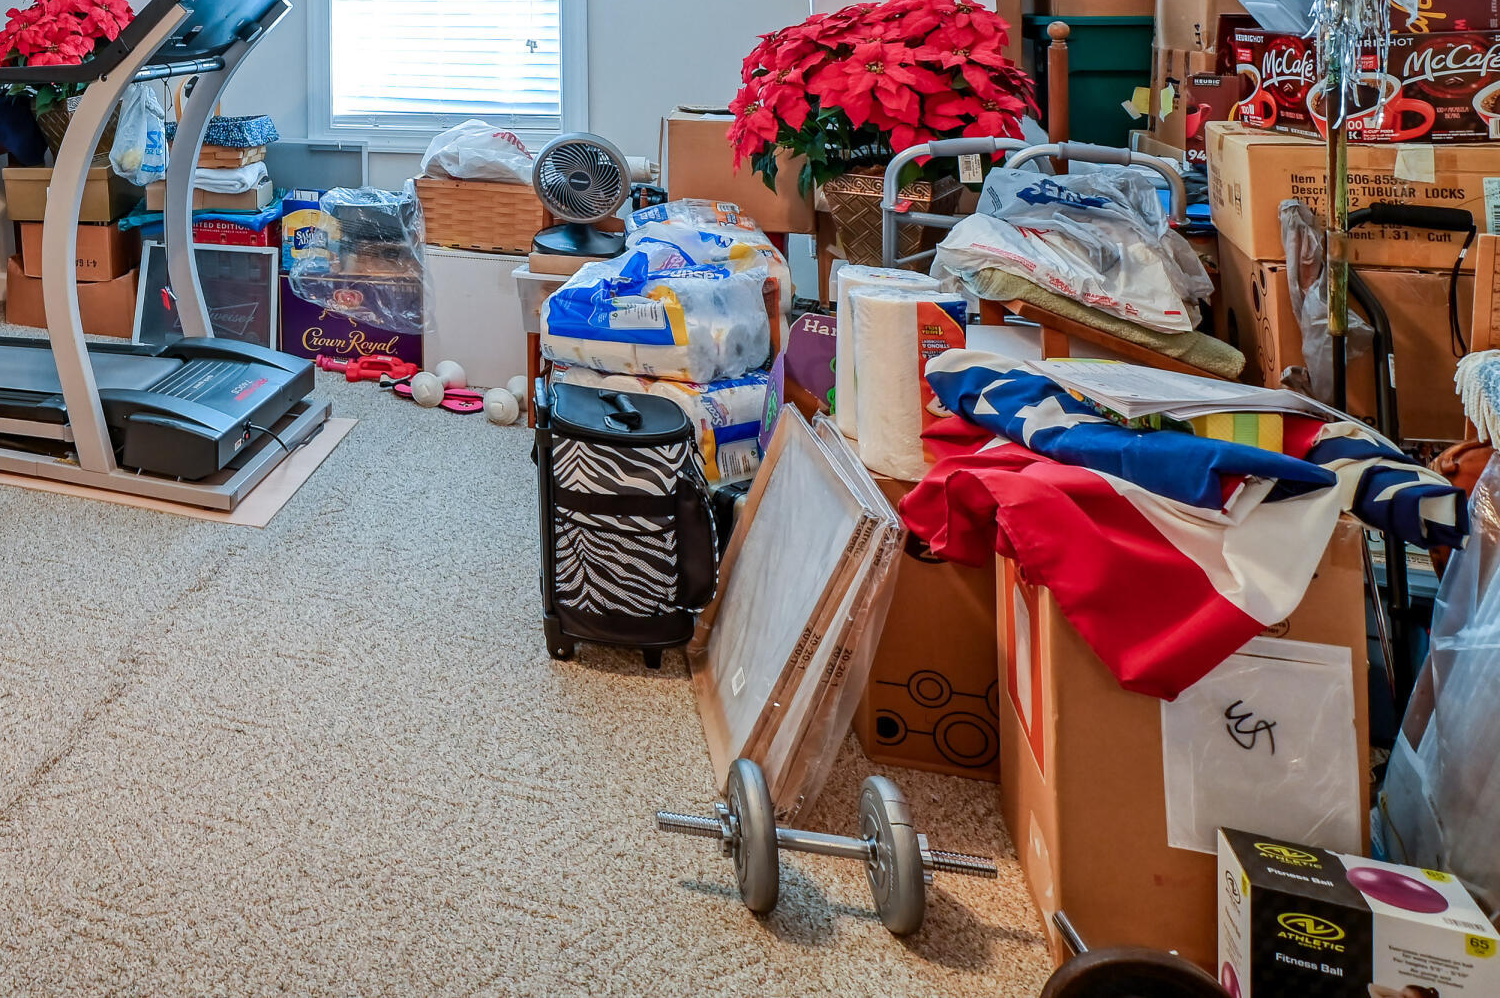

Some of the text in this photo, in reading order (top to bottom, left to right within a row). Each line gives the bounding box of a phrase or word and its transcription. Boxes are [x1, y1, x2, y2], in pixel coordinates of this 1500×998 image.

[1194, 78, 1221, 86] KEURIG
[1291, 174, 1316, 184] Item
[1361, 187, 1416, 198] TUBULAR
[1425, 188, 1465, 199] LOCKS
[302, 327, 399, 356] Crown Royal
[1266, 866, 1335, 887] Fitness Ball
[1277, 931, 1346, 953] ATHLETIC
[1469, 937, 1490, 950] 65
[1275, 952, 1344, 977] Fitness Ball
